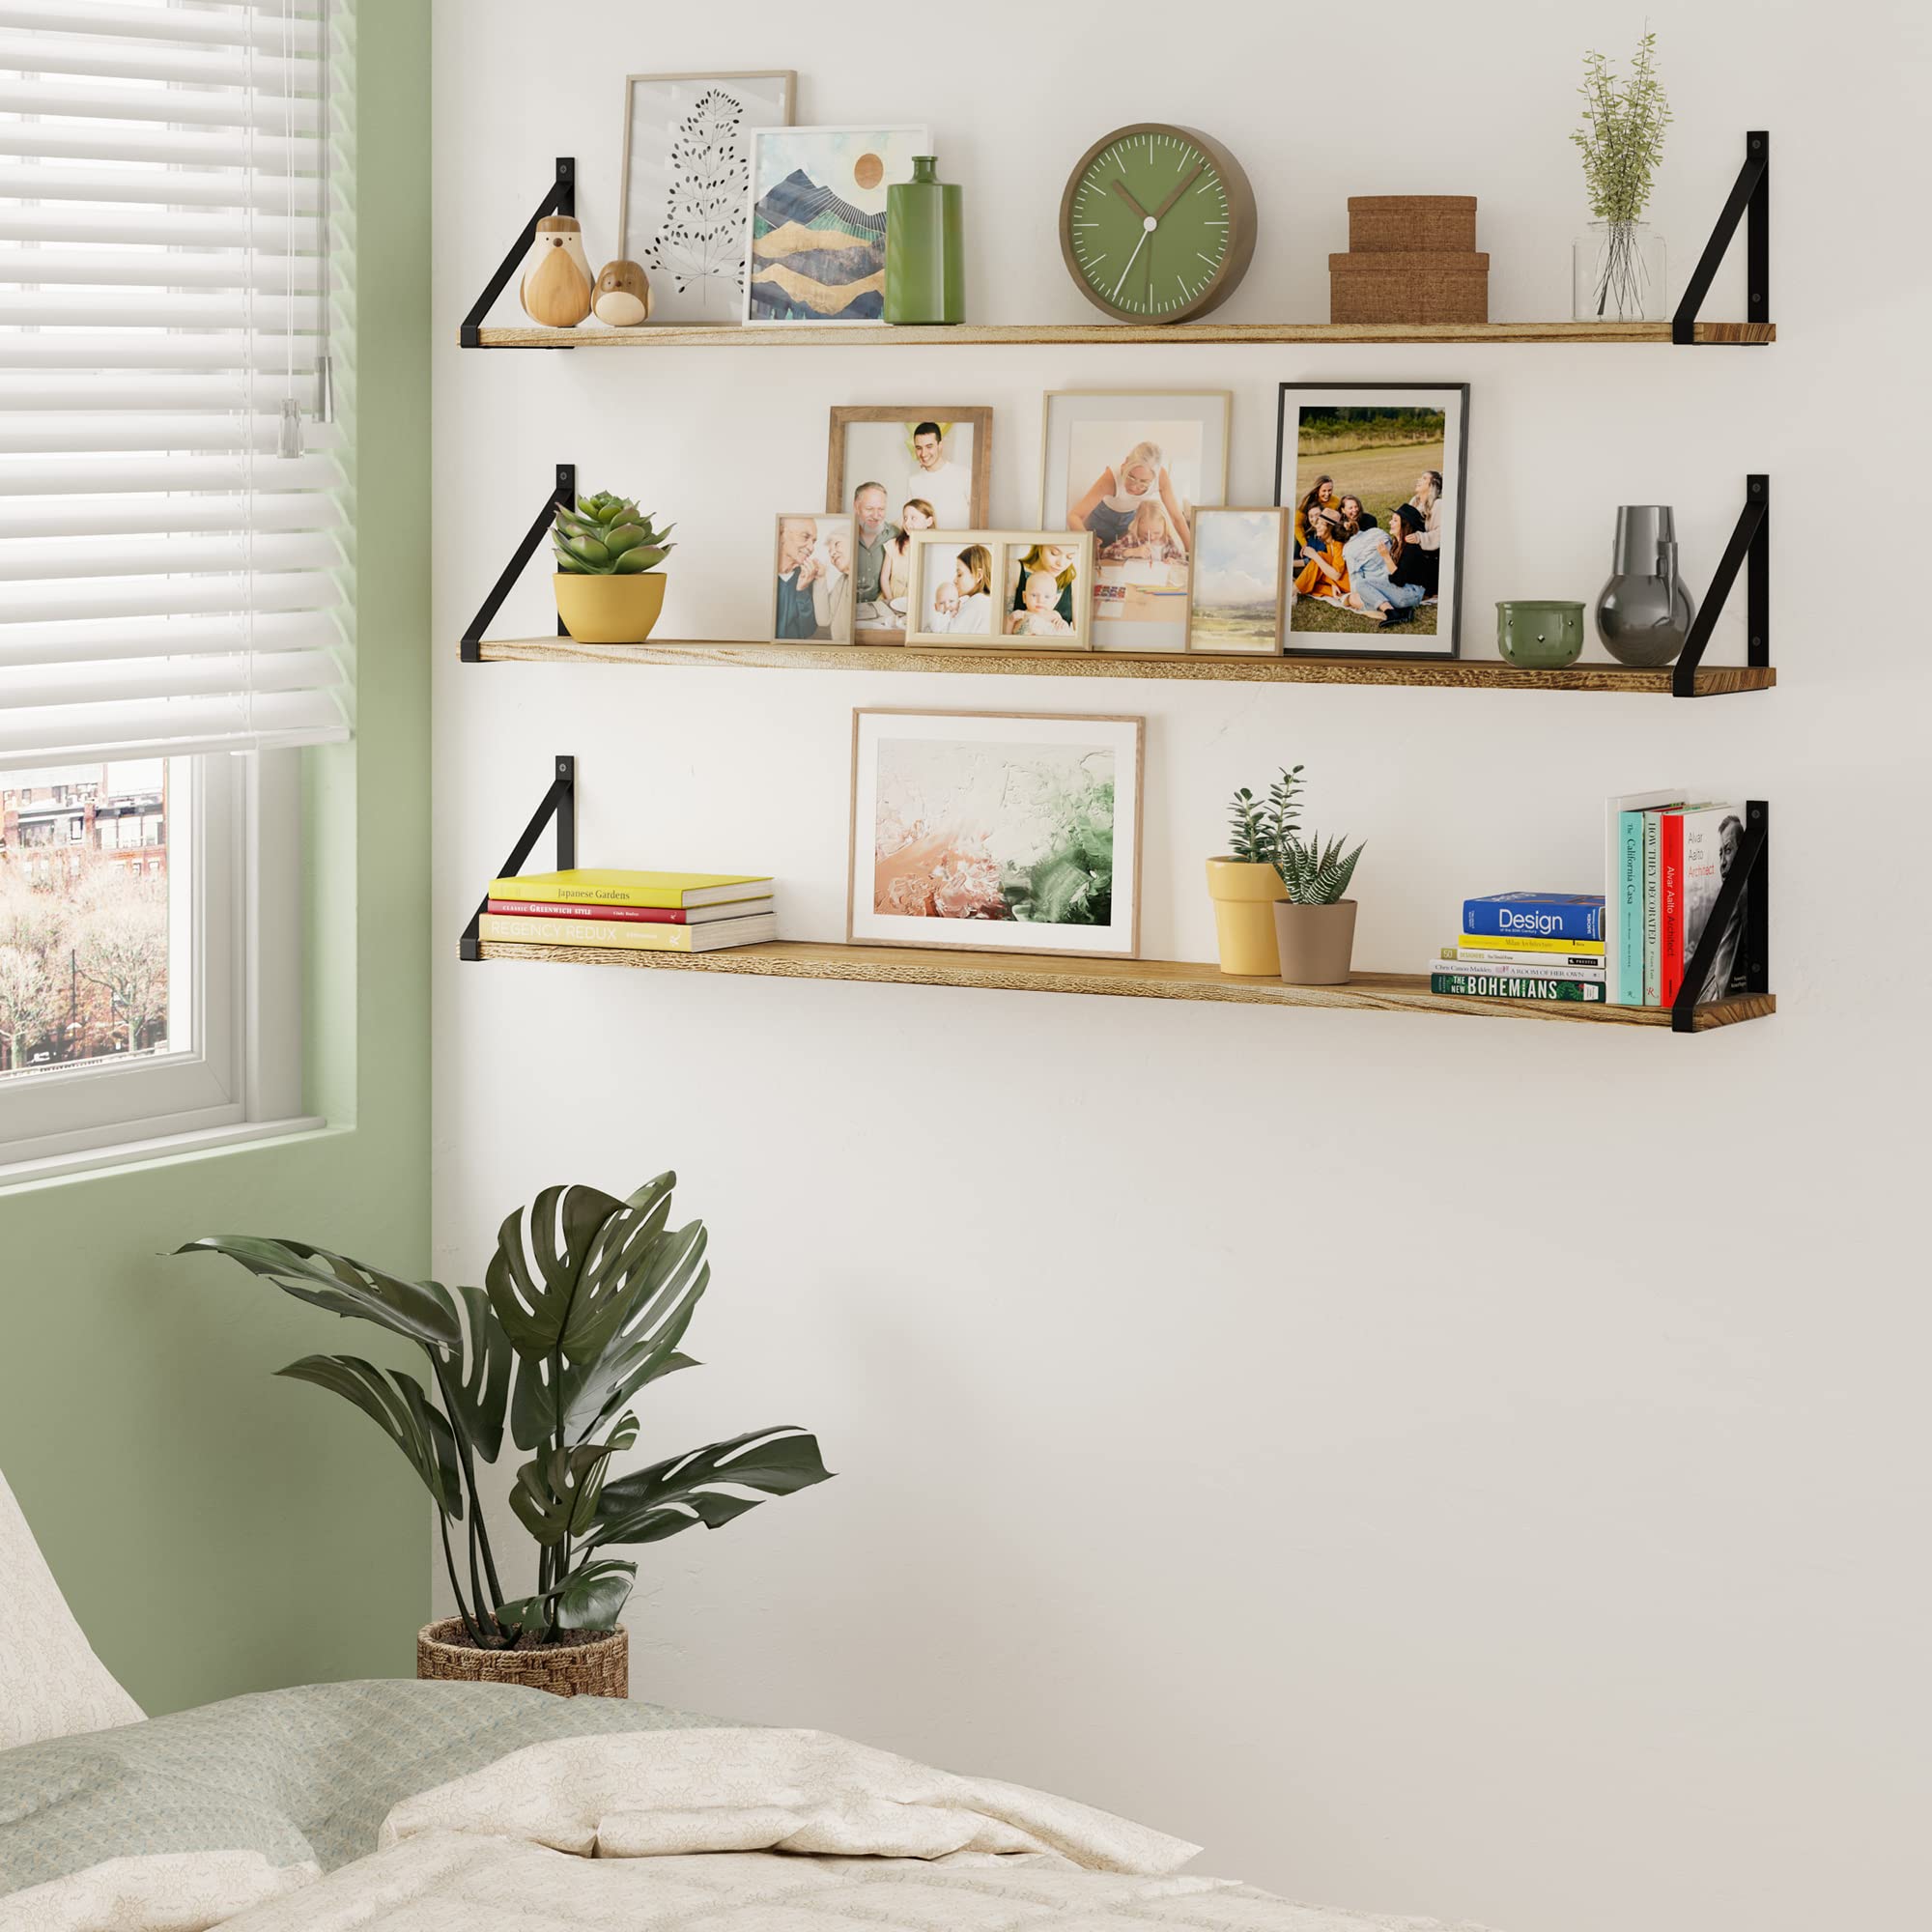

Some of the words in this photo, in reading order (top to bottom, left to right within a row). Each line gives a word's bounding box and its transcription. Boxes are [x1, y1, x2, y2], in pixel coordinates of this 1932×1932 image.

[1648, 823, 1657, 845] HOW
[1688, 832, 1703, 843] Alvar
[1627, 838, 1636, 882] California
[1648, 848, 1657, 876] THEY
[557, 888, 594, 899] Japanese
[595, 890, 630, 899] Gardens
[1627, 884, 1636, 904] Casa
[529, 904, 572, 915] GREENWICH
[1648, 881, 1657, 945] DECORATED
[492, 921, 560, 937] REGENCY
[566, 924, 616, 940] REDUX
[1499, 908, 1563, 934] Design
[1667, 916, 1676, 956] Architect
[1443, 950, 1453, 958] 50
[1451, 985, 1465, 994] NEW
[1453, 976, 1465, 984] THE
[1468, 976, 1557, 1000] BOHEMIANS
